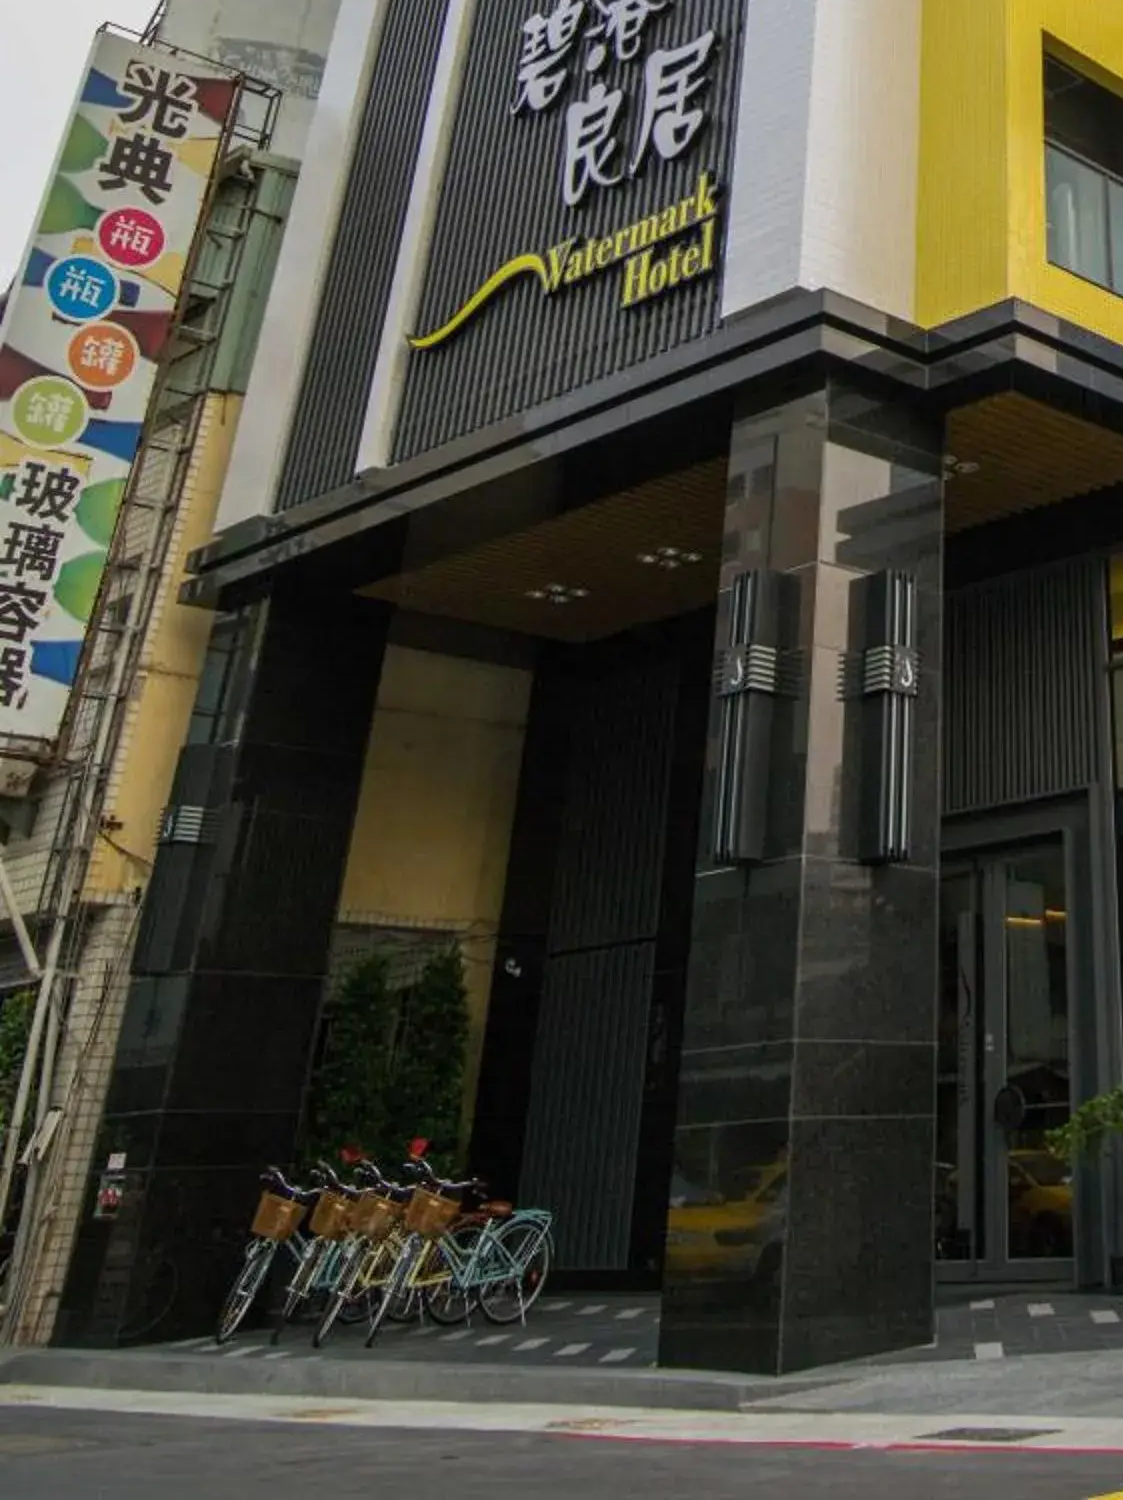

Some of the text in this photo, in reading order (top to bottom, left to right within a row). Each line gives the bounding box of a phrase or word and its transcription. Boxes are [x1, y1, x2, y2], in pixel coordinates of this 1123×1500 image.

[97, 61, 194, 204] 光典
[534, 172, 717, 296] Watermark
[621, 217, 715, 308] Hotel
